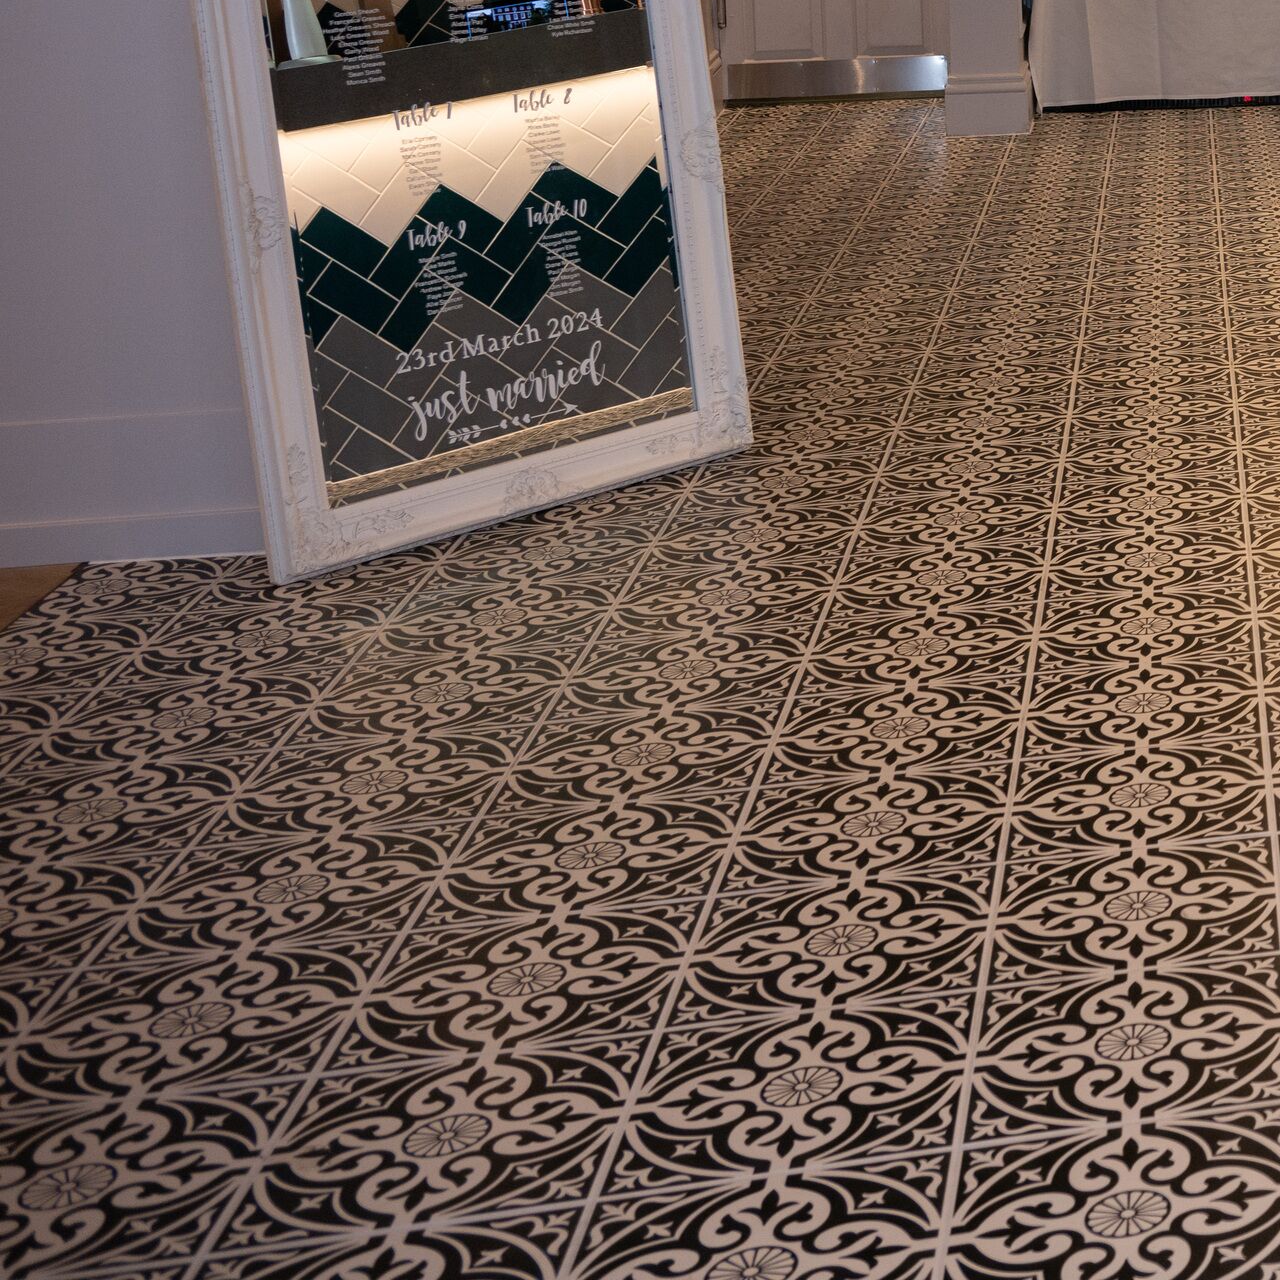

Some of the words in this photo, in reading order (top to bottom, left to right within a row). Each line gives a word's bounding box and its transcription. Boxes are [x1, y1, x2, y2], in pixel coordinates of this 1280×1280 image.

[369, 75, 386, 83] Smith
[512, 88, 555, 113] Table
[392, 102, 439, 130] Table
[525, 200, 569, 228] Table
[573, 198, 588, 219] 10
[405, 221, 453, 251] Table
[458, 220, 467, 239] 9
[396, 341, 456, 374] 23rd
[460, 324, 541, 359] March
[547, 308, 604, 339] 2024
[407, 370, 480, 441] just
[486, 340, 606, 411] married
